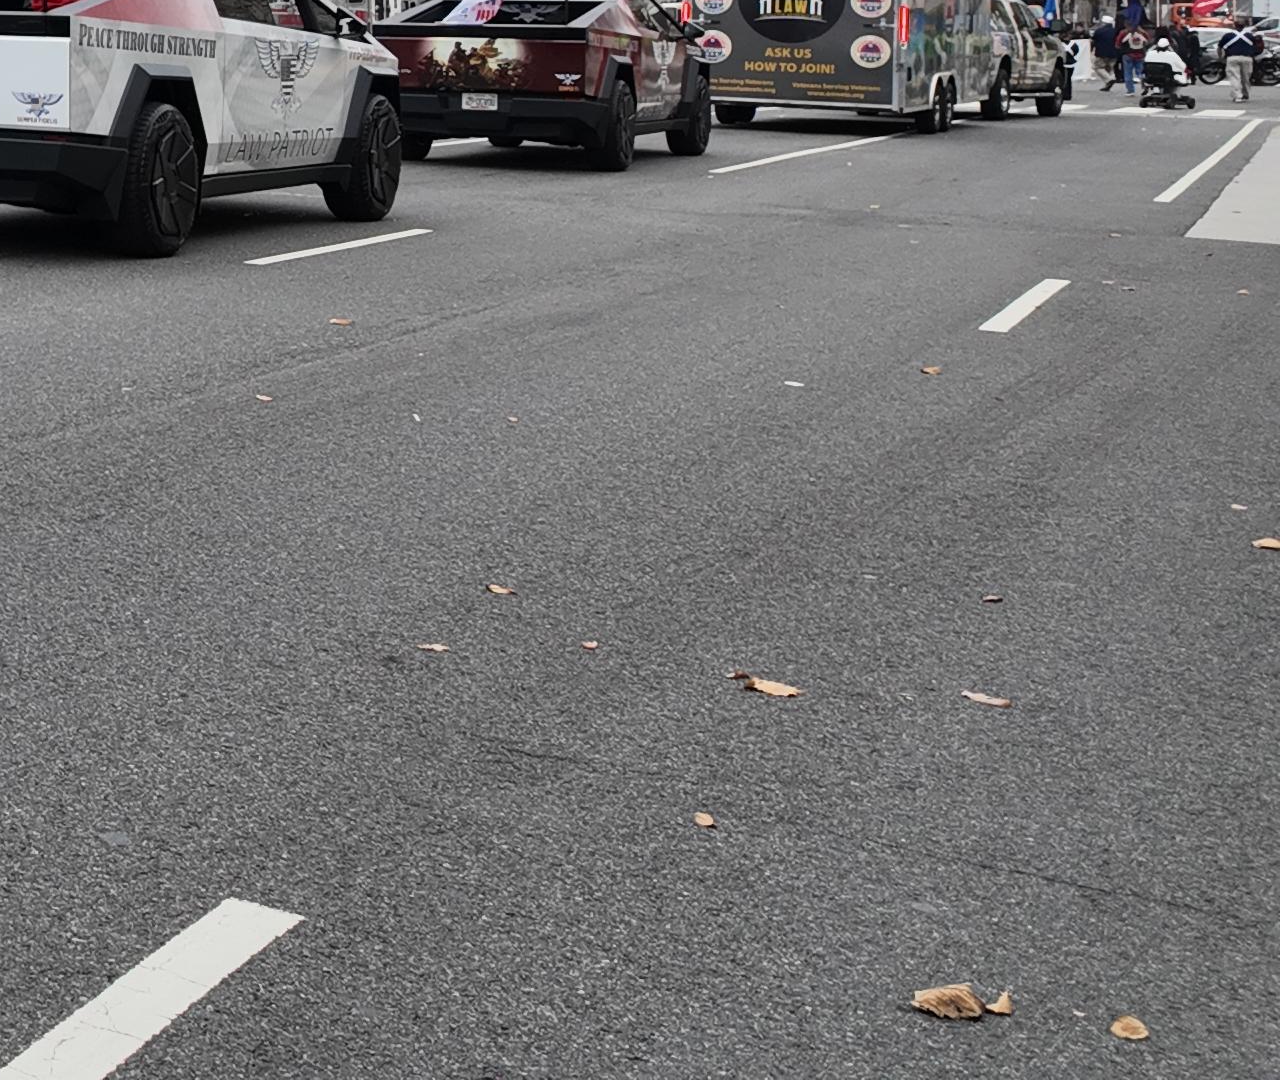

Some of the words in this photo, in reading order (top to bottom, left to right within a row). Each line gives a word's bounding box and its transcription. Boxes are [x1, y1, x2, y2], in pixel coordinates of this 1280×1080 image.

[775, 0, 808, 14] LAW
[78, 23, 113, 49] PEACE
[115, 29, 165, 55] THROUGH
[166, 35, 217, 59] STRENGTH
[764, 47, 791, 58] ASK
[794, 48, 813, 59] US
[744, 61, 777, 72] HOW
[779, 62, 797, 73] TO
[799, 63, 836, 75] JOIN!
[224, 131, 270, 163] LAW
[268, 127, 334, 160] PATRIOT
